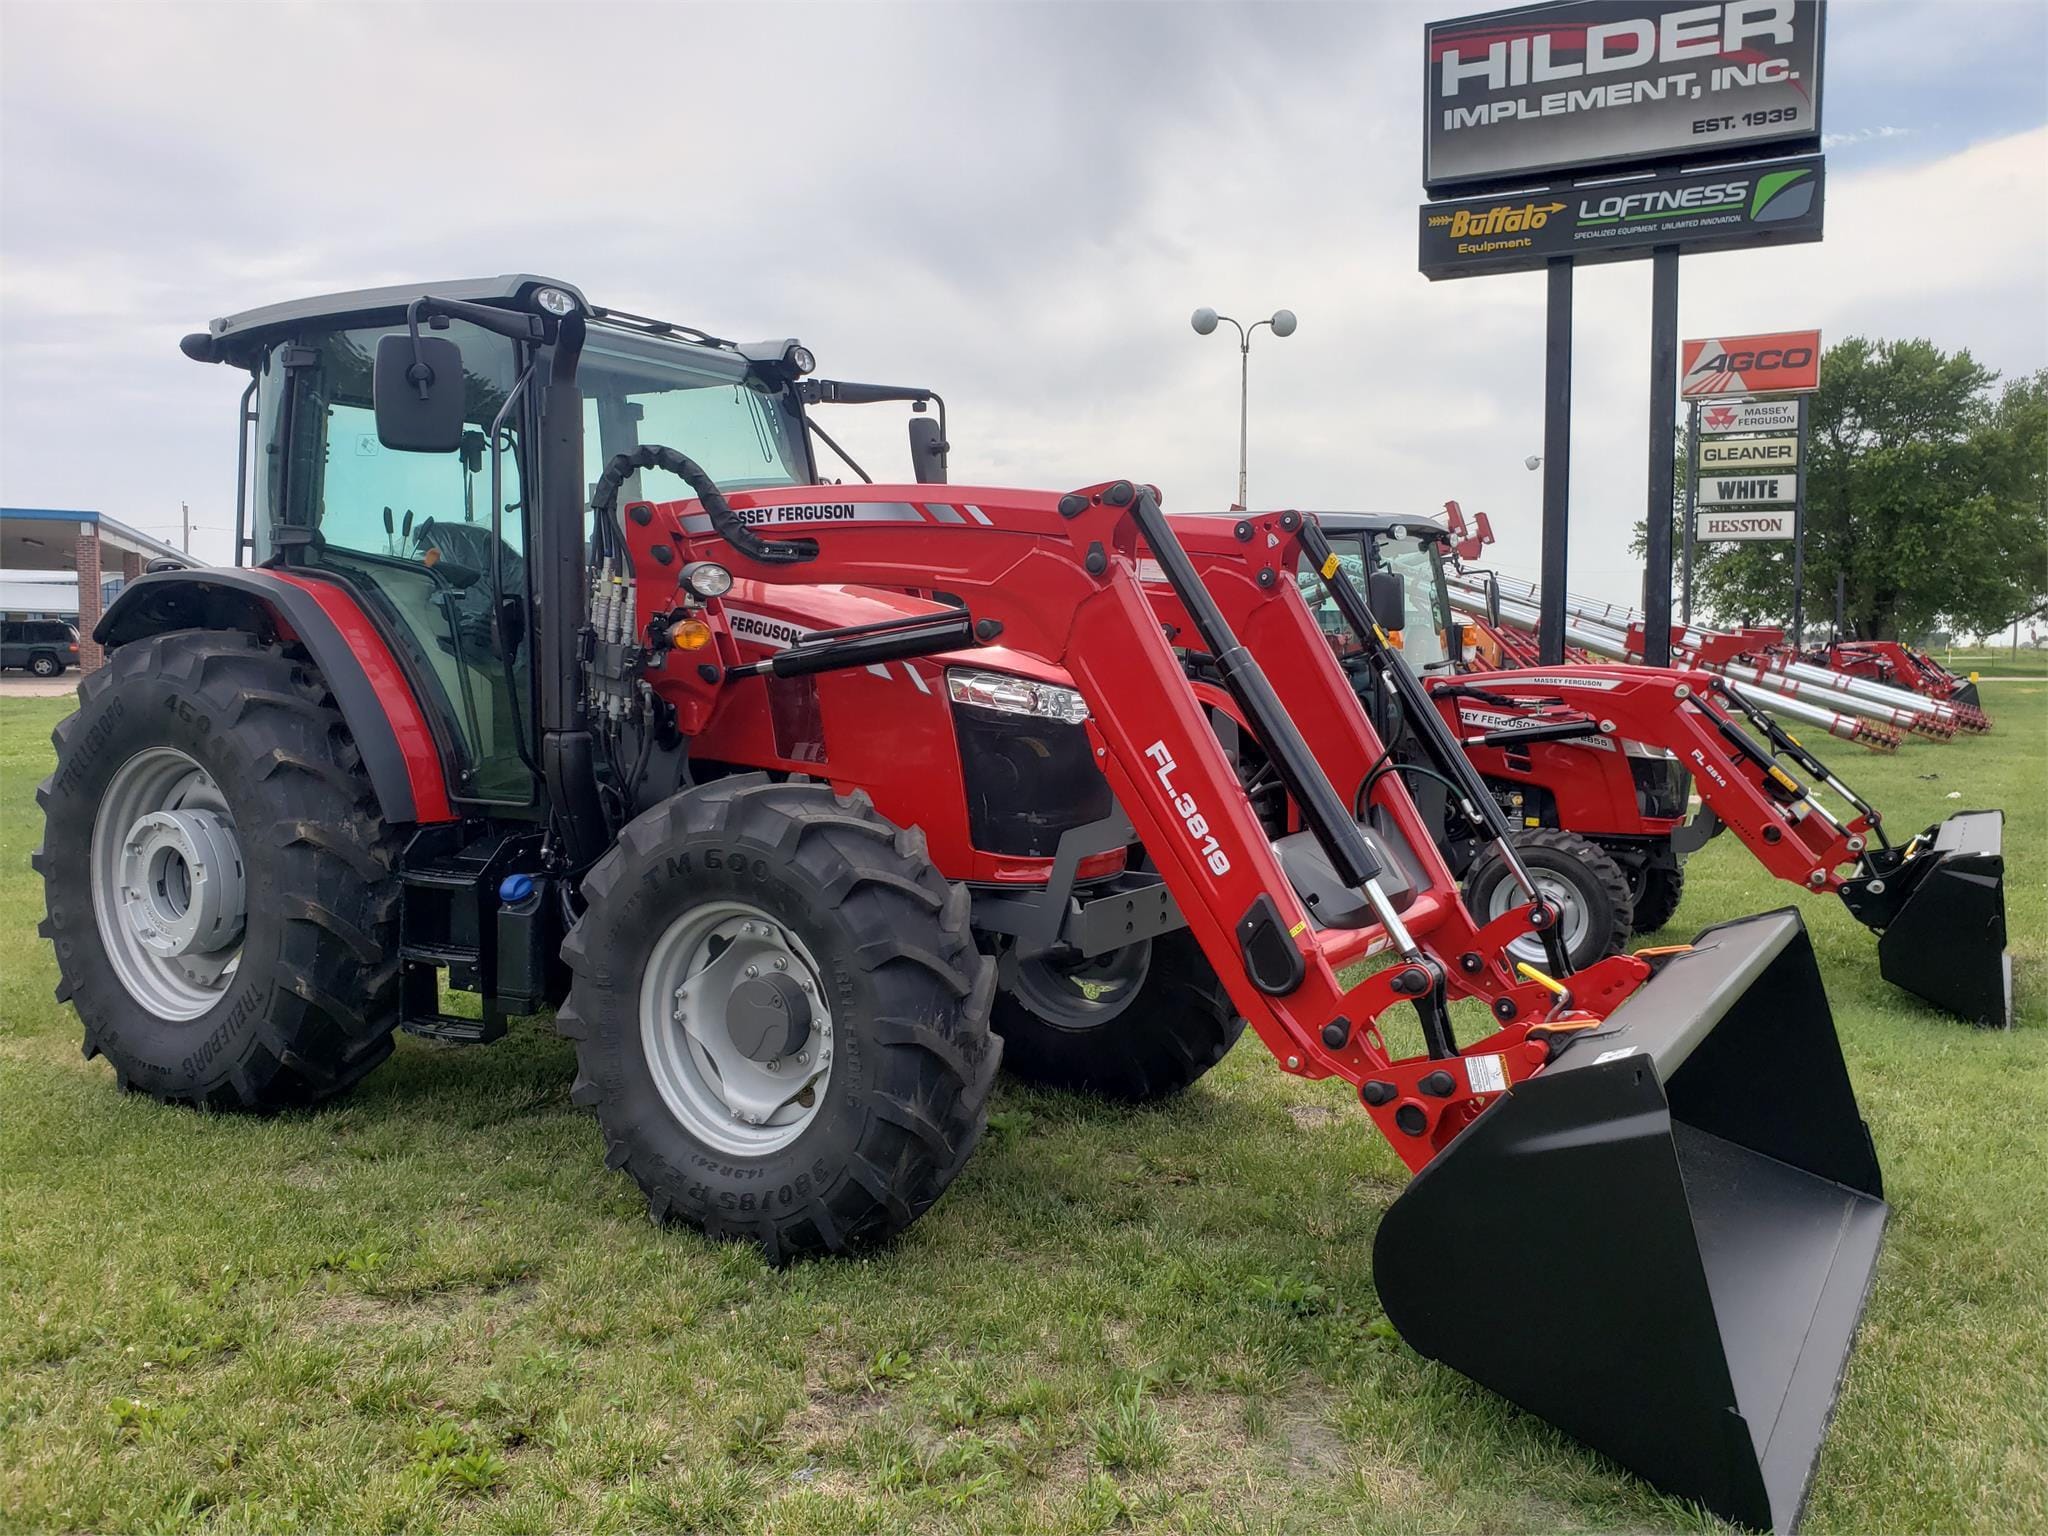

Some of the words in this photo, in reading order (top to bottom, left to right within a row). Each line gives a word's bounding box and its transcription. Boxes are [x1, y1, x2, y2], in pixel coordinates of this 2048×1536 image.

[1441, 0, 1796, 97] HILDER
[1444, 73, 1701, 130] IMPLEMENT,
[1711, 58, 1800, 91] INC.
[1692, 117, 1736, 134] EST.
[1742, 107, 1798, 128] 1939
[1578, 181, 1750, 219] LOFTNESS
[1450, 204, 1548, 238] Buffalo
[1573, 228, 1616, 240] SPECIALIZED
[1661, 219, 1699, 231] UNLIMITED
[1457, 238, 1532, 253] Equipment
[1690, 348, 1812, 375] AGCO
[1738, 415, 1795, 426] FERGUSON
[1744, 406, 1789, 416] MASSEY
[1704, 445, 1792, 461] GLEANER
[1717, 479, 1778, 500] WHITE
[738, 508, 773, 524] SSEY
[778, 503, 855, 522] FERGUSON
[1708, 518, 1783, 533] HESSTON
[1565, 678, 1602, 687] FERGUSON
[1691, 748, 1705, 766] FL
